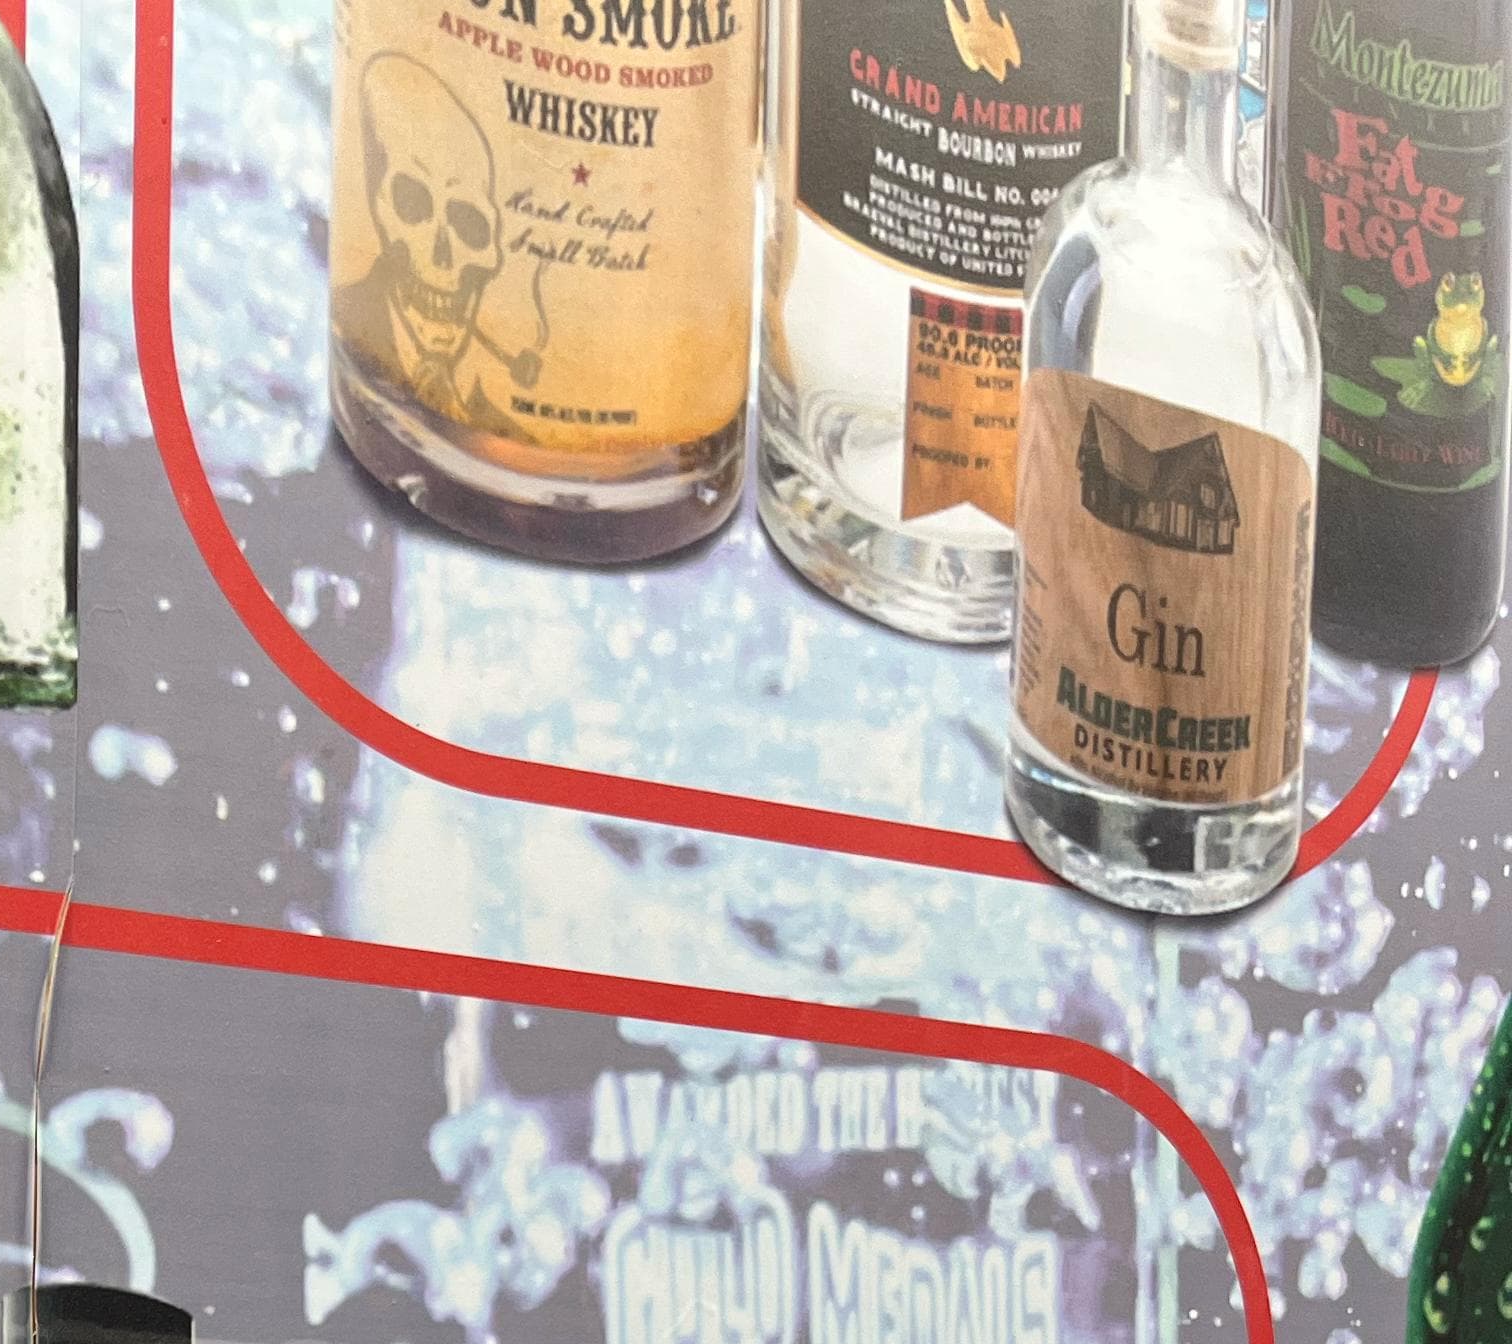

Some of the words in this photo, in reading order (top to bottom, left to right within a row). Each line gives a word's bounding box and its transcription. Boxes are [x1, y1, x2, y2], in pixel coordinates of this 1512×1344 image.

[439, 10, 523, 63] APPLE
[532, 46, 611, 85] WOOD
[619, 62, 714, 89] SMOKED
[503, 78, 659, 148] WHISKEY
[849, 47, 941, 115] GRAND
[951, 91, 1084, 135] AMERICAN
[850, 86, 934, 139] STRAIGHT
[937, 125, 1017, 168] BOURBON
[874, 145, 936, 188] MASH
[942, 171, 988, 201] BILL
[1330, 107, 1424, 197] Fat
[510, 227, 583, 264] Small
[576, 204, 654, 241] Crafted
[1320, 191, 1432, 289] Red
[1106, 582, 1206, 678] Gin
[1073, 722, 1228, 785] DISTILLERY
[811, 1066, 890, 1154] THE
